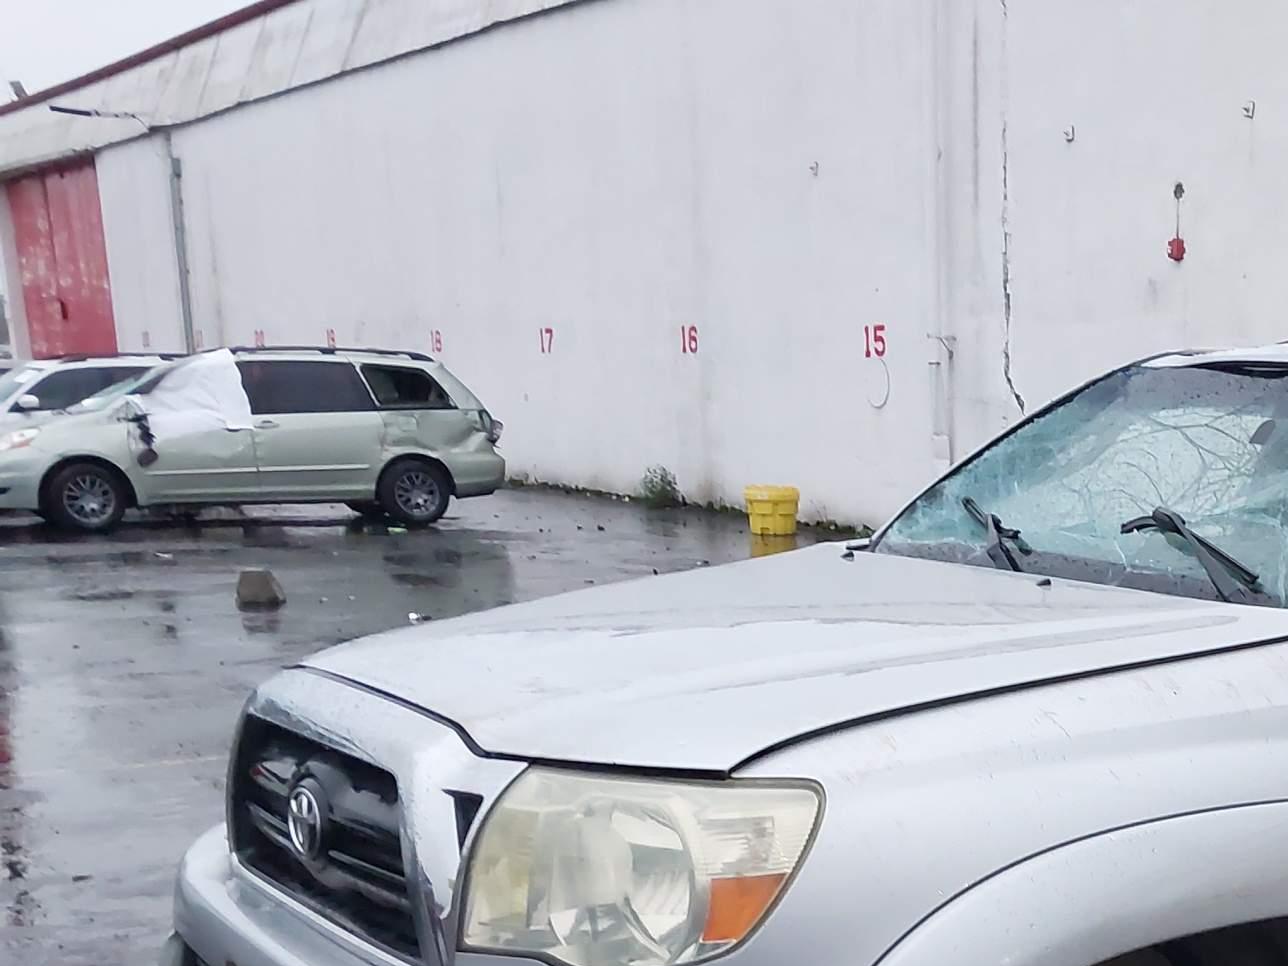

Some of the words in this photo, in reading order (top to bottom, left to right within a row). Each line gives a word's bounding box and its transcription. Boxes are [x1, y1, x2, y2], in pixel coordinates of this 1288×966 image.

[540, 328, 553, 353] 17
[681, 325, 698, 353] 16
[864, 324, 886, 358] 15
